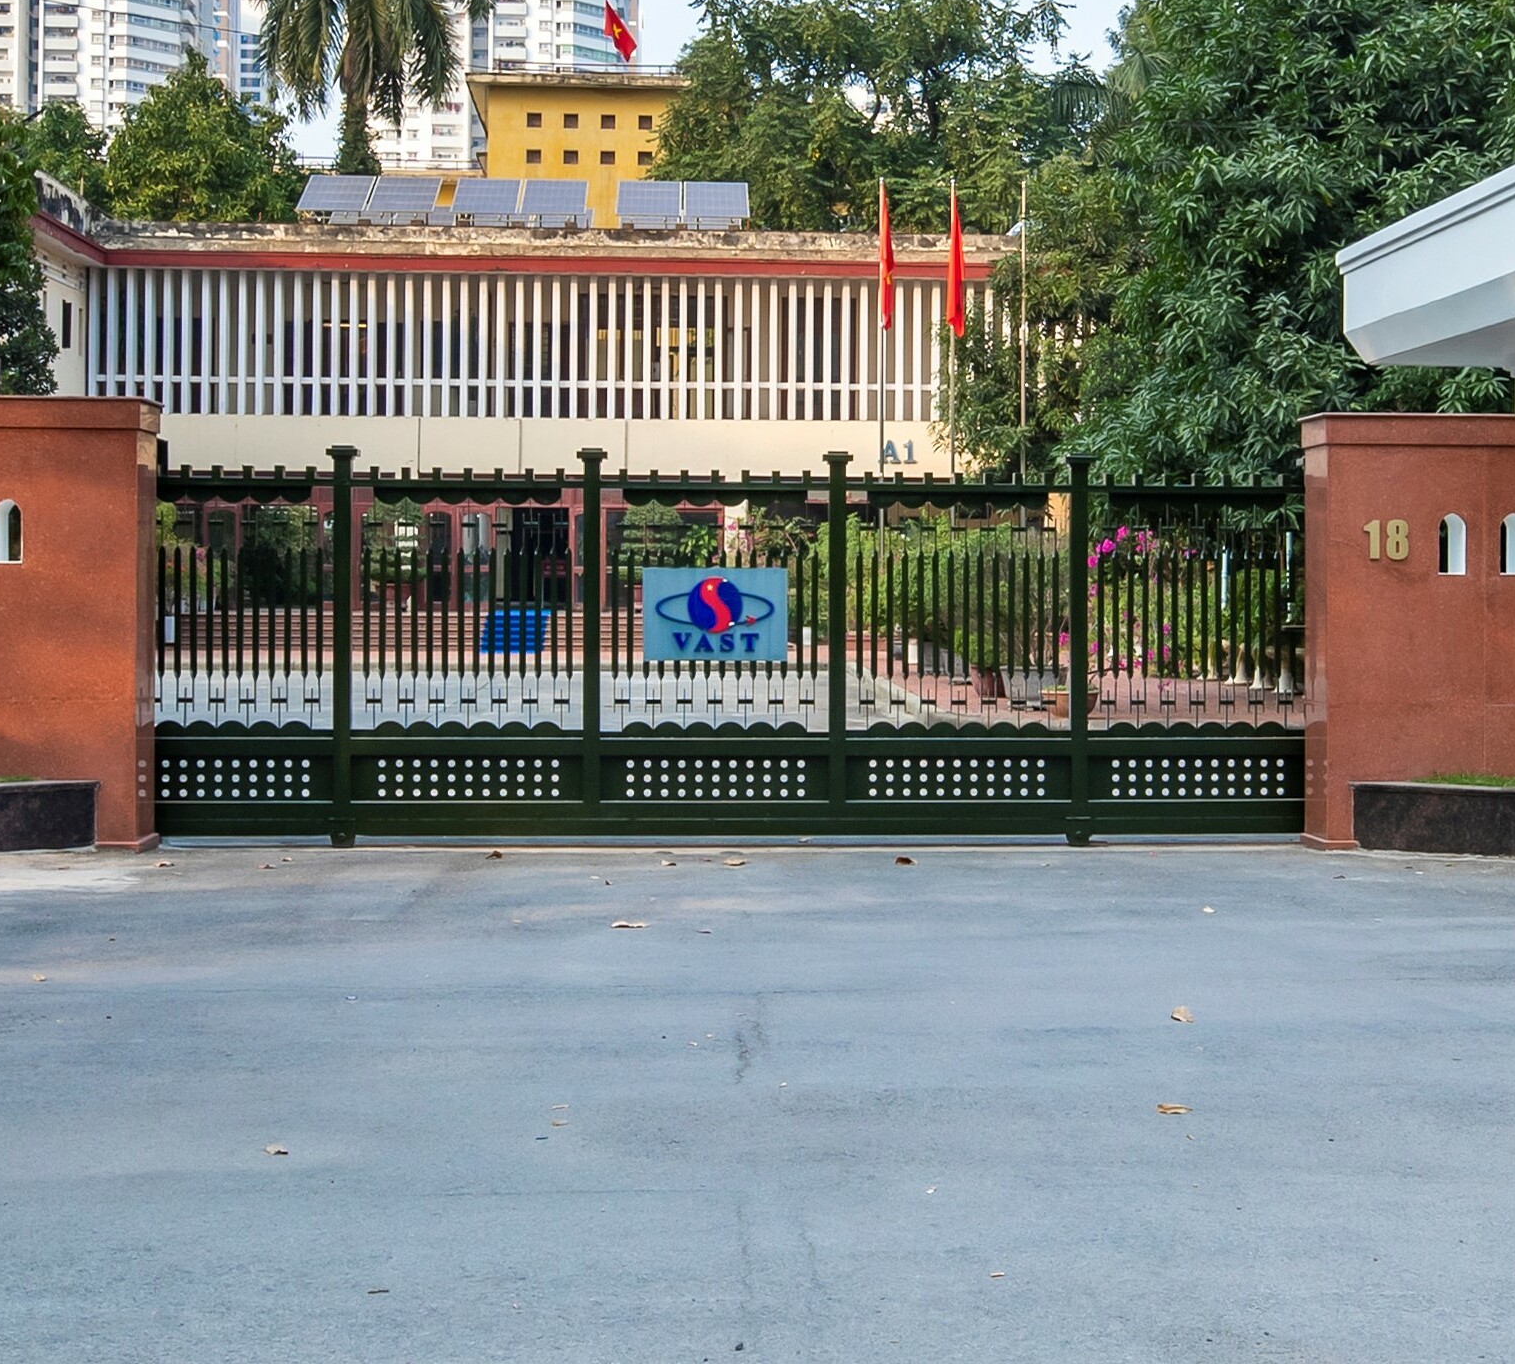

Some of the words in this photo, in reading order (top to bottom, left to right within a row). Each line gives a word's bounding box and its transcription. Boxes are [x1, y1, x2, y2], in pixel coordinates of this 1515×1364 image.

[878, 439, 917, 464] A1
[1363, 519, 1409, 561] 18
[672, 632, 760, 653] VAST
